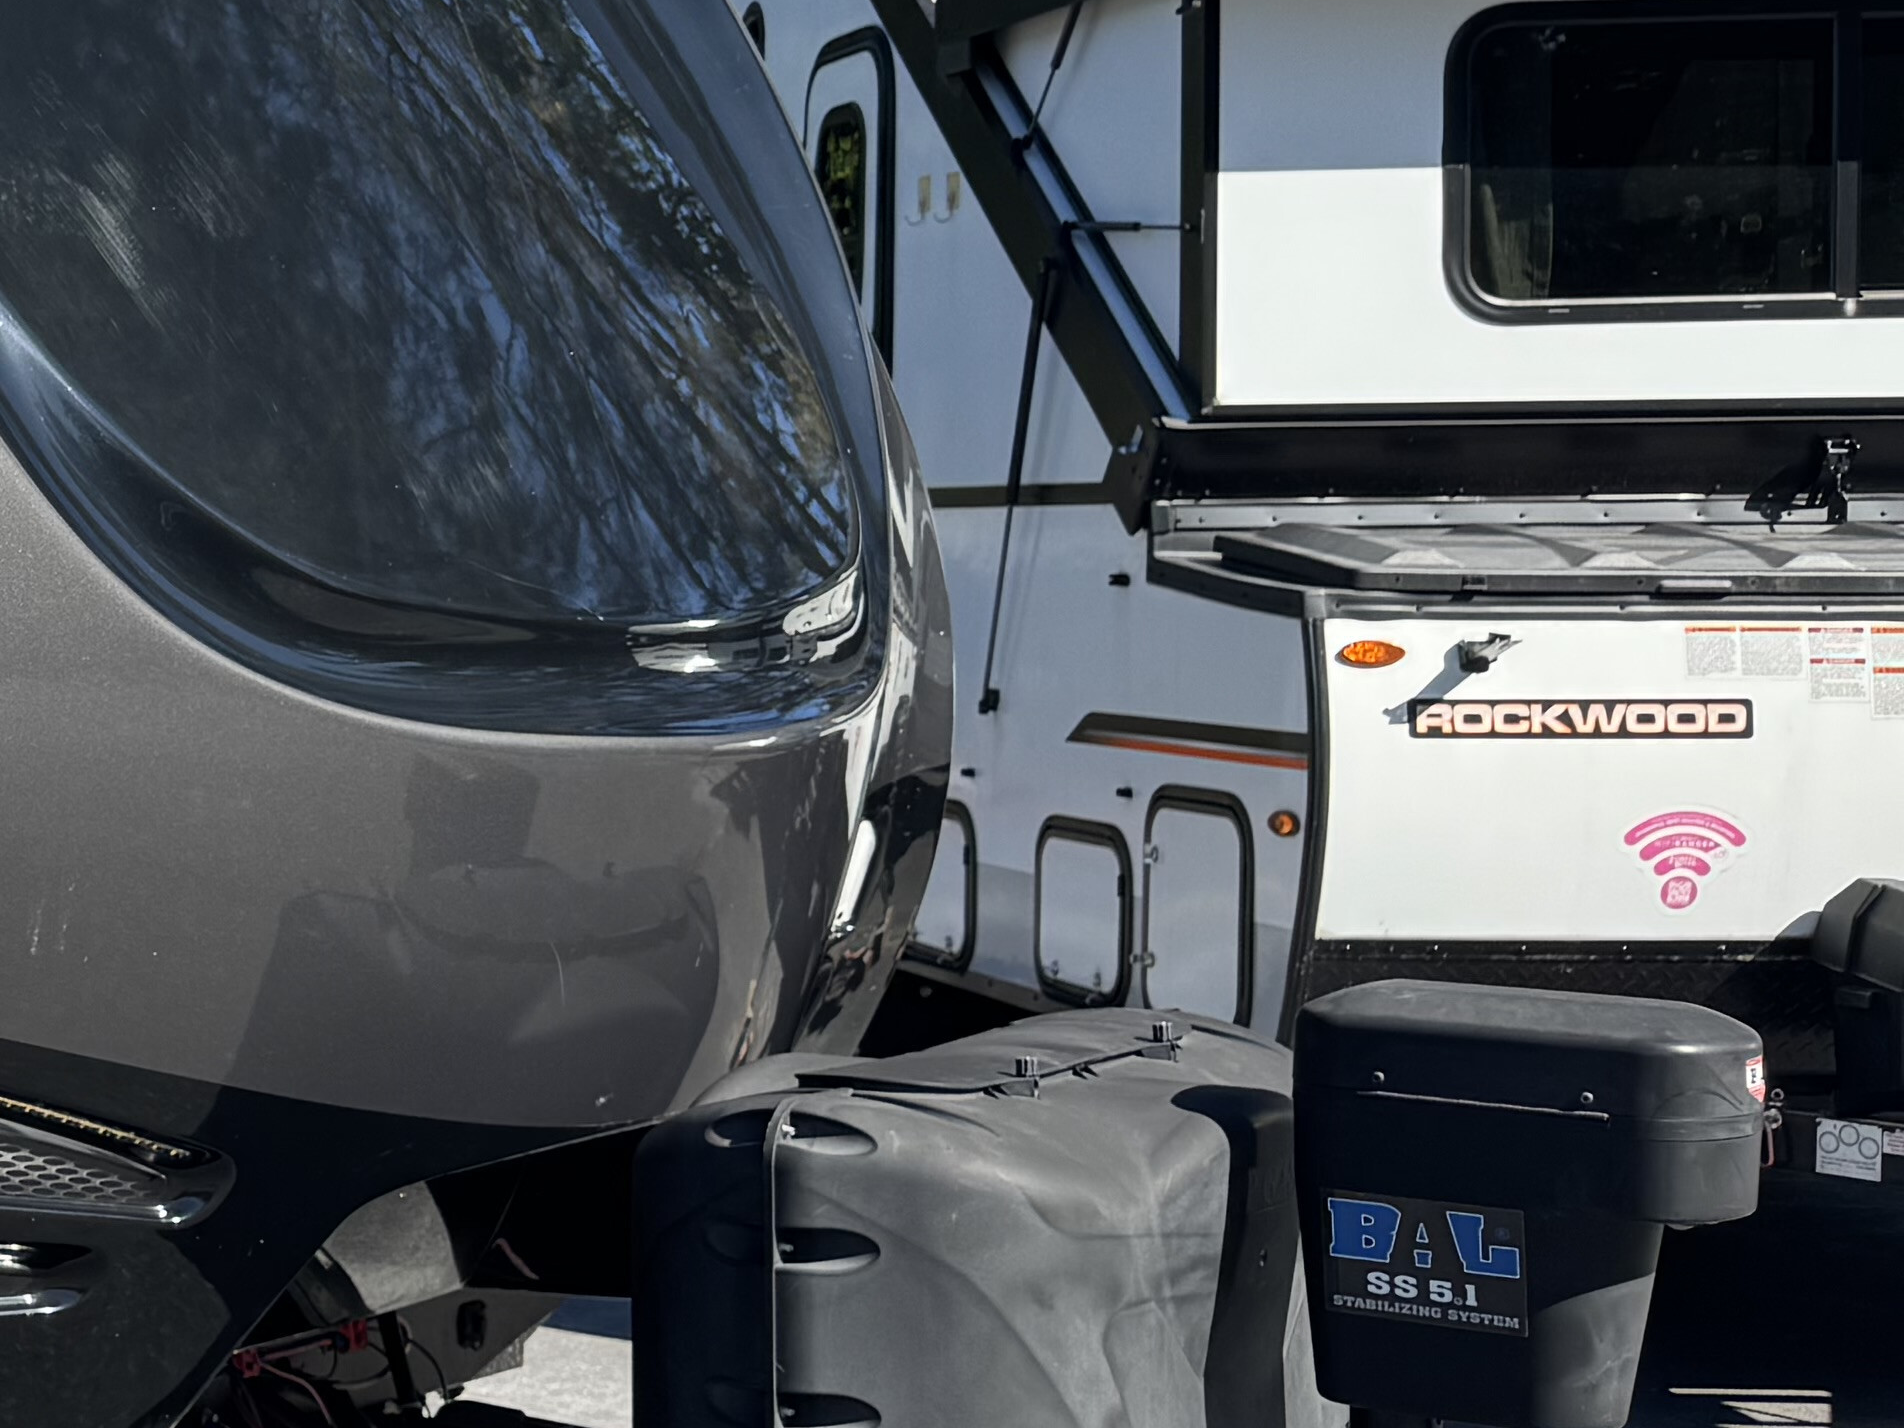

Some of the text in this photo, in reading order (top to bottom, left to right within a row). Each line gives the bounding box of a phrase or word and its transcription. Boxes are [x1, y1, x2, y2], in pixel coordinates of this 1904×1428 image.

[1415, 702, 1748, 734] ROCKWOOD
[1327, 1196, 1521, 1280] BAL
[1366, 1271, 1479, 1308] SS 5.1
[1332, 1294, 1521, 1330] STABILIZING SYSTEM
